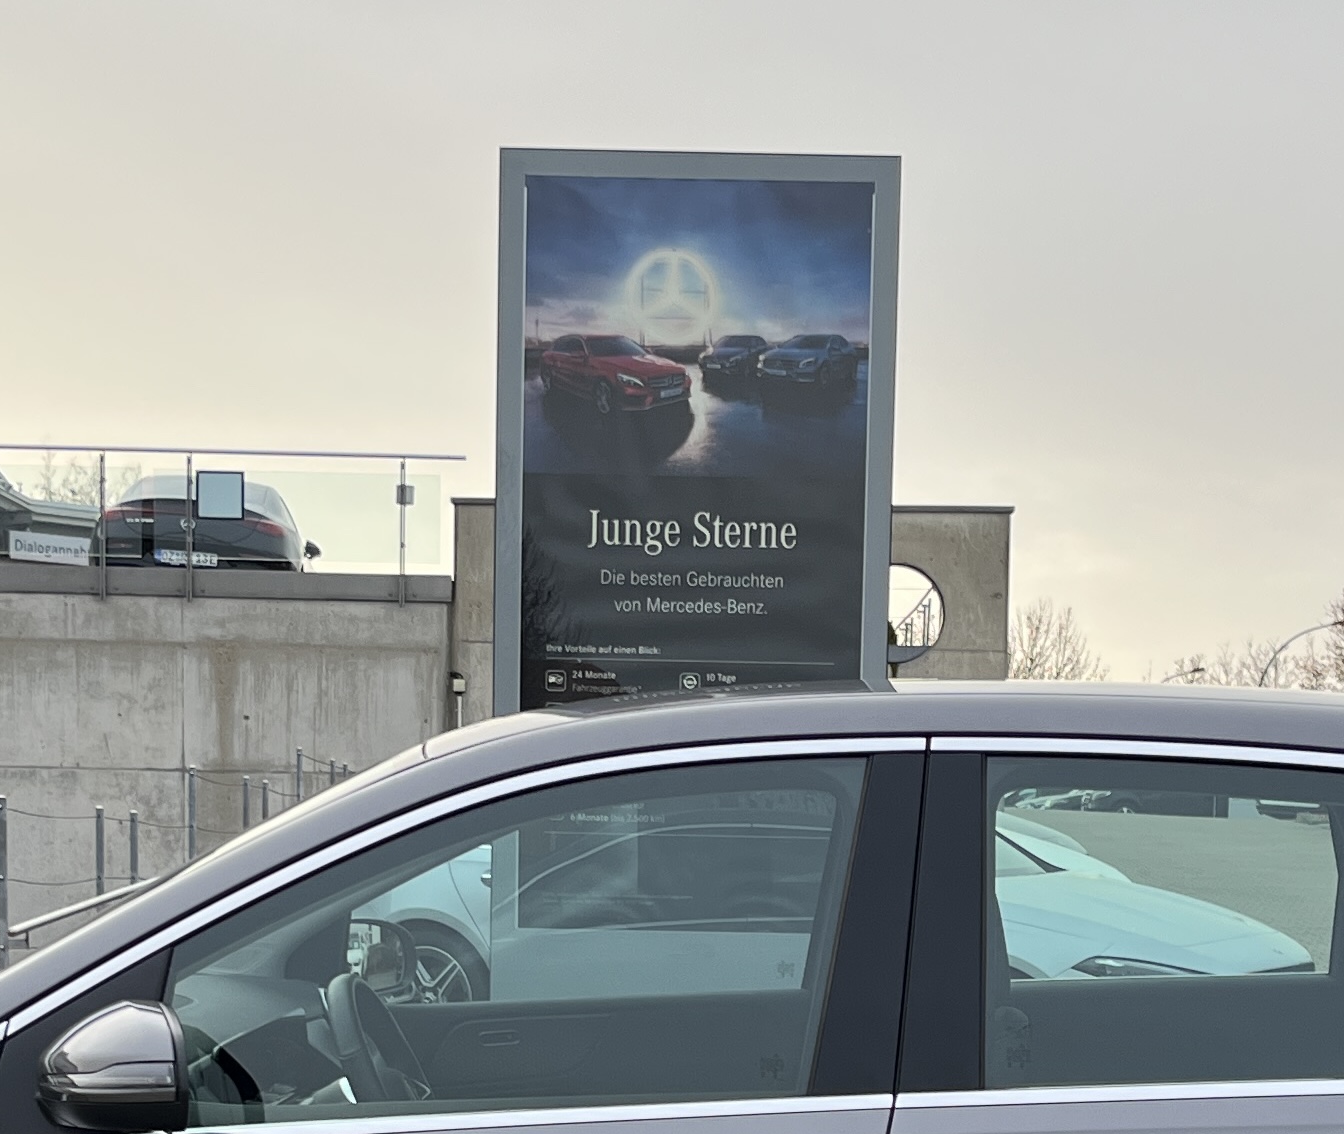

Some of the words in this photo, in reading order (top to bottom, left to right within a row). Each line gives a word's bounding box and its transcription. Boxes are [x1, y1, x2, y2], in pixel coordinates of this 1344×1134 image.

[587, 509, 681, 556] Junge
[692, 511, 798, 550] Sterne
[14, 538, 88, 560] Dialogannah
[600, 569, 625, 586] Die
[630, 570, 682, 587] besten
[686, 571, 784, 589] Gebrauchten
[613, 600, 641, 613] von
[647, 597, 768, 615] Mercedes-Benz.
[546, 644, 563, 653] Ihre
[565, 644, 597, 653] Vorteile
[598, 645, 612, 654] auf
[613, 645, 637, 654] einen
[572, 670, 583, 679] 24
[585, 670, 617, 680] Monate
[706, 673, 715, 682] 10
[717, 673, 737, 683] Tage
[577, 812, 609, 822] Monate
